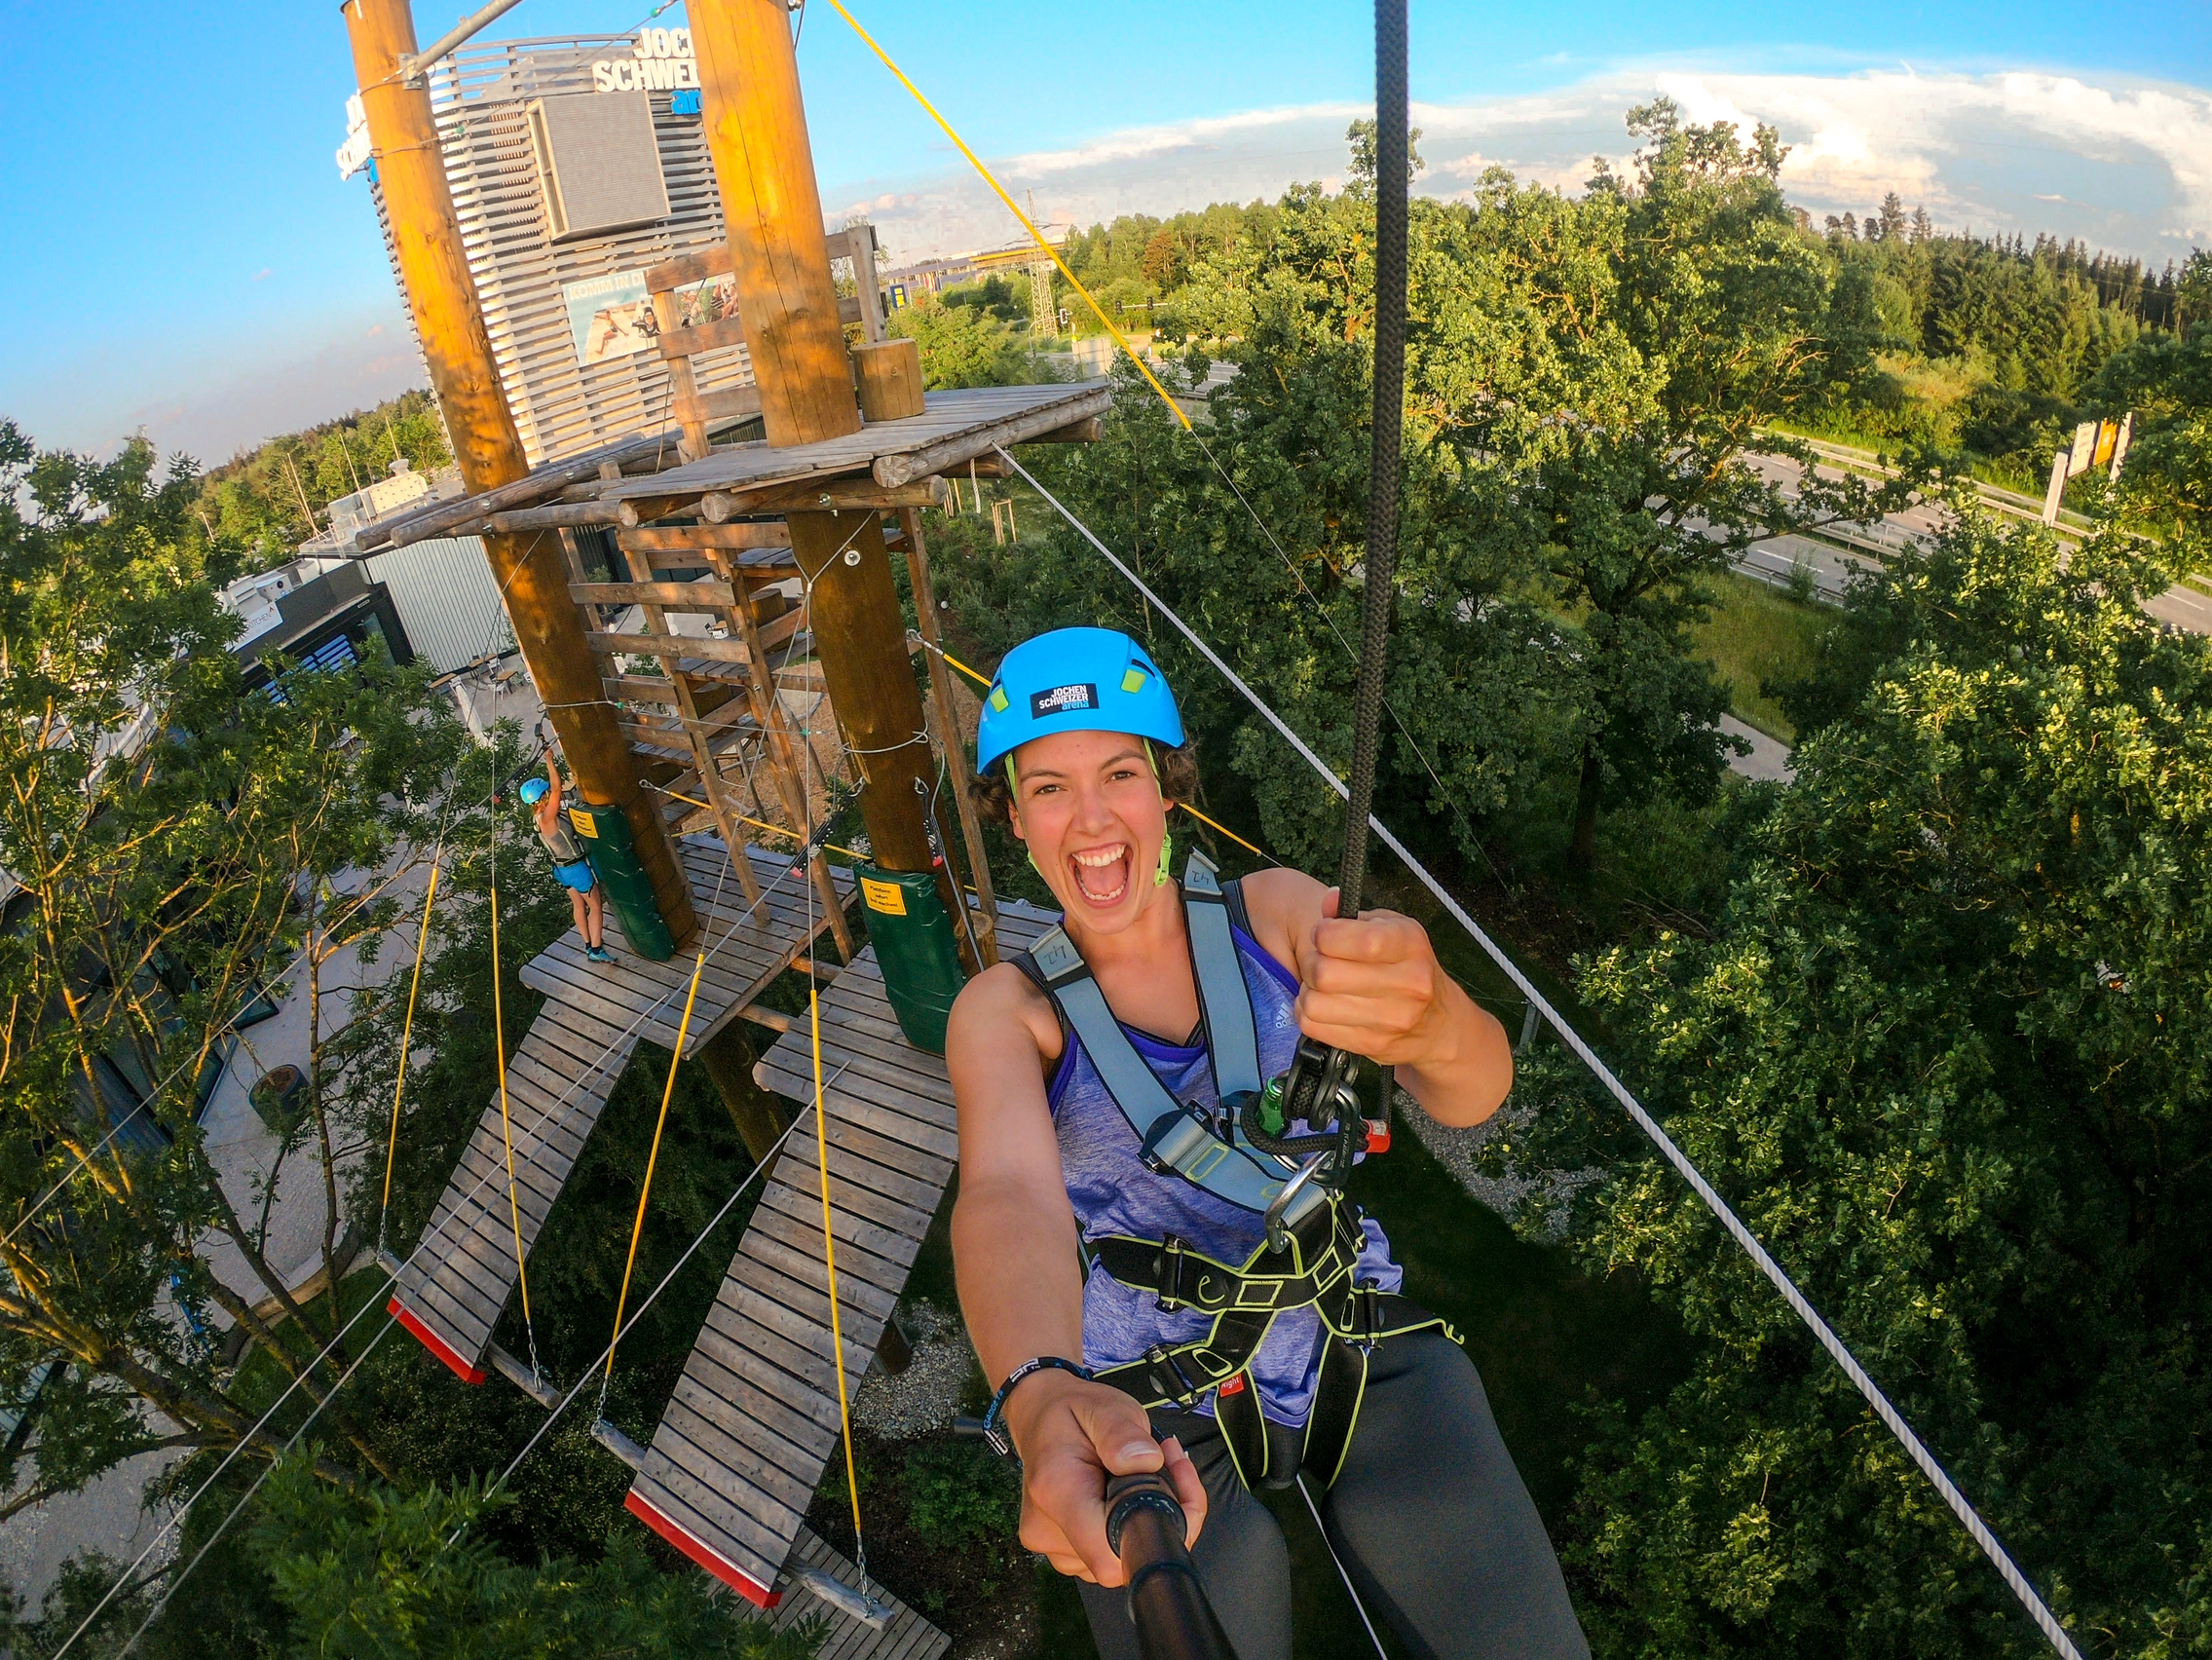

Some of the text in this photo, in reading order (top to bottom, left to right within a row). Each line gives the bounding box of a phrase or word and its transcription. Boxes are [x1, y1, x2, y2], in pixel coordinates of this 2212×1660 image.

[592, 58, 700, 92] SCHWEI
[569, 280, 614, 300] KOMM
[615, 276, 630, 290] IN
[1051, 685, 1087, 698] JOCHEN
[1038, 694, 1089, 709] SCHWEIZER
[1062, 700, 1089, 710] arena
